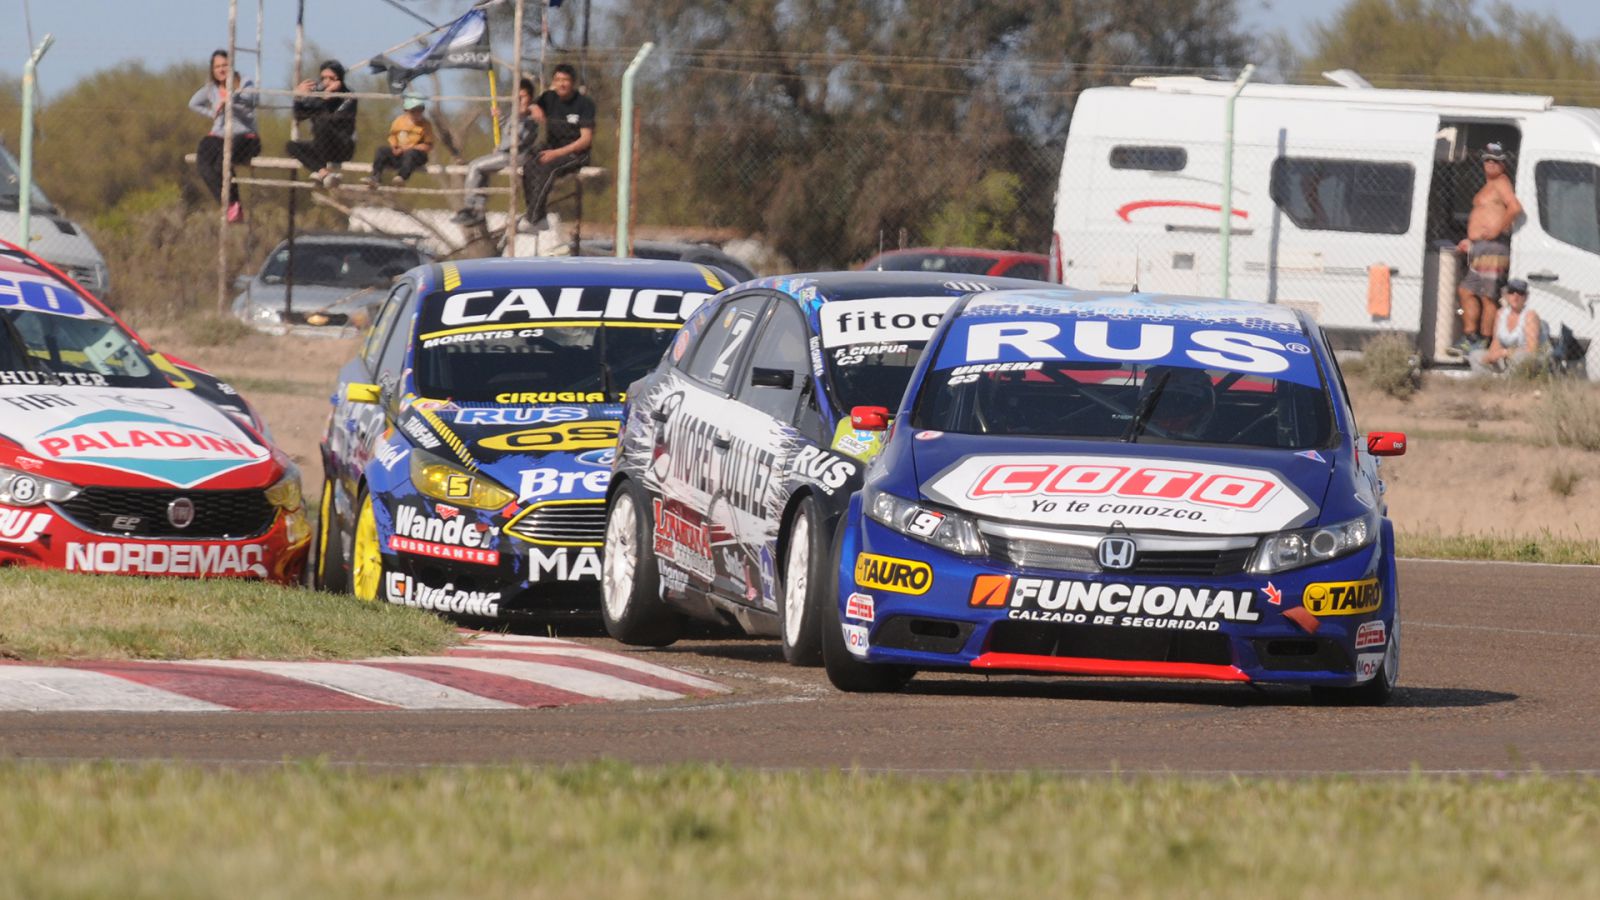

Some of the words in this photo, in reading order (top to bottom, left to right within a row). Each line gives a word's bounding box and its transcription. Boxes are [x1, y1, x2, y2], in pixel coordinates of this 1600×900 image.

[423, 330, 513, 348] MORIATIS
[518, 328, 544, 338] C3
[712, 318, 752, 377] 2
[966, 321, 1289, 373] RUS
[837, 355, 865, 366] C3
[850, 344, 908, 356] CHAPUR
[947, 374, 979, 386] C3
[950, 362, 1044, 376] URCERA
[2, 393, 77, 411] FIAT
[496, 392, 605, 404] CIRUGIA
[453, 407, 589, 425] RUS
[38, 430, 259, 459] PALADINI
[791, 444, 856, 489] RUS
[14, 479, 35, 501] 8
[448, 476, 468, 497] 5
[972, 464, 1276, 508] COTO
[1030, 500, 1058, 513] Yo
[1066, 500, 1090, 514] te
[1098, 502, 1207, 523] conozco.
[910, 513, 941, 537] 9
[393, 537, 497, 563] LUBRICANTES
[864, 558, 929, 590] TAURO
[1010, 578, 1260, 620] FUNCIONAL
[1329, 582, 1380, 611] TAURO
[1008, 610, 1087, 624] CALZADO
[1093, 614, 1116, 626] DE
[1121, 617, 1220, 631] SEGURIDAD
